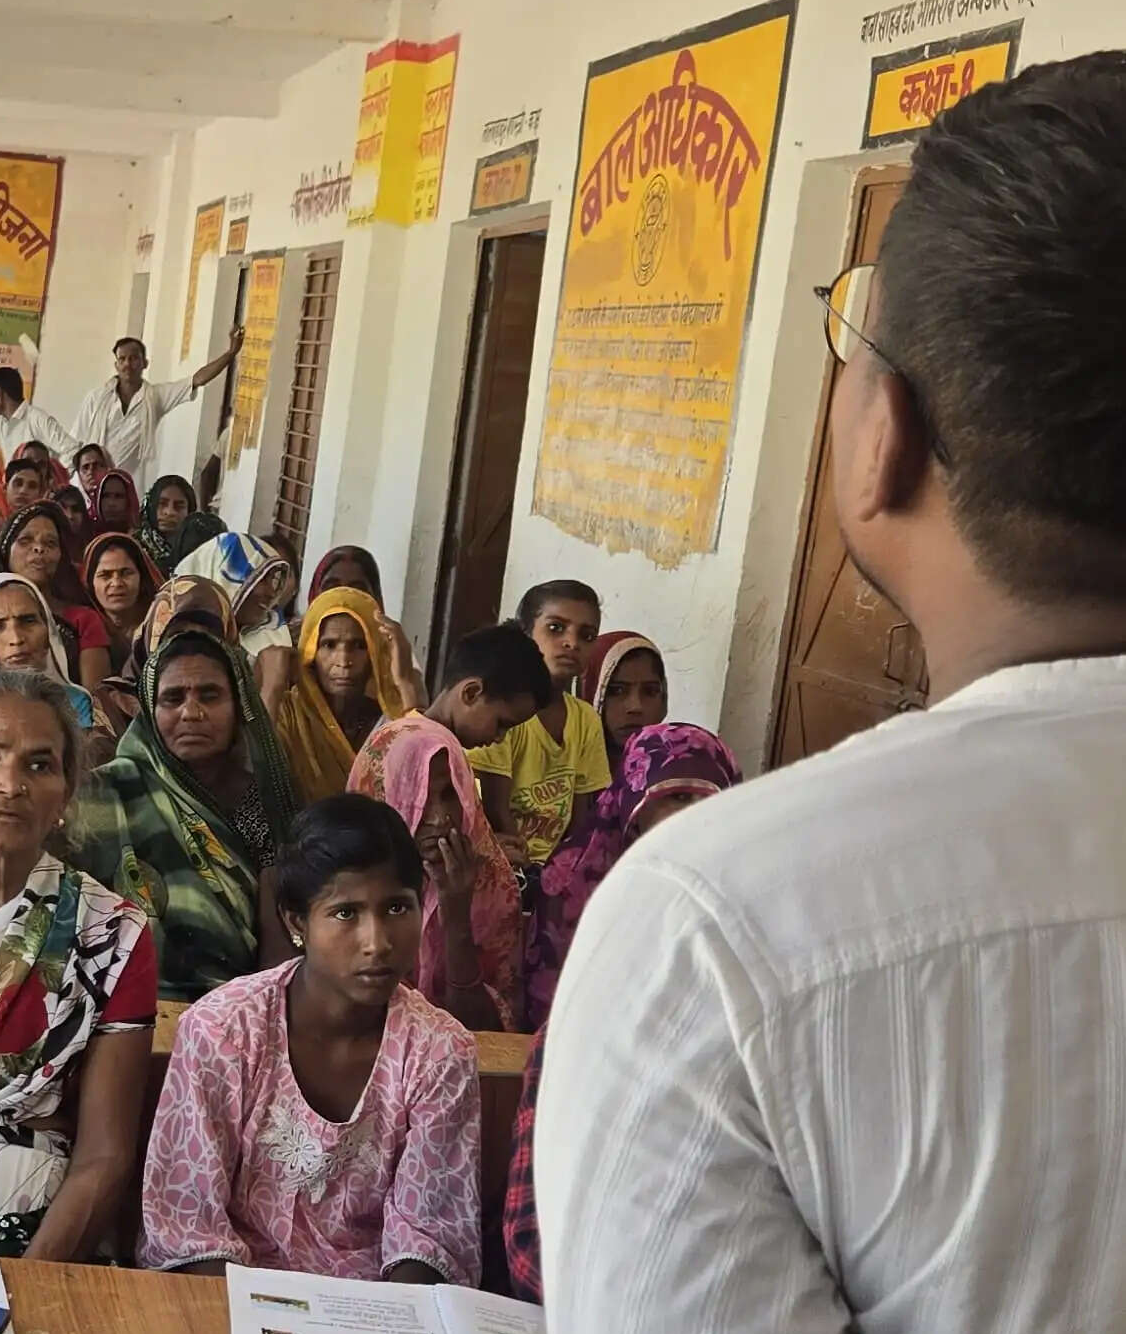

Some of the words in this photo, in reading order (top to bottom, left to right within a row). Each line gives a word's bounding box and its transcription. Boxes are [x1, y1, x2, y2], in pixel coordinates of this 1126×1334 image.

[580, 104, 643, 237] बाल
[640, 48, 761, 261] अधिकार
[534, 779, 569, 802] RIDE
